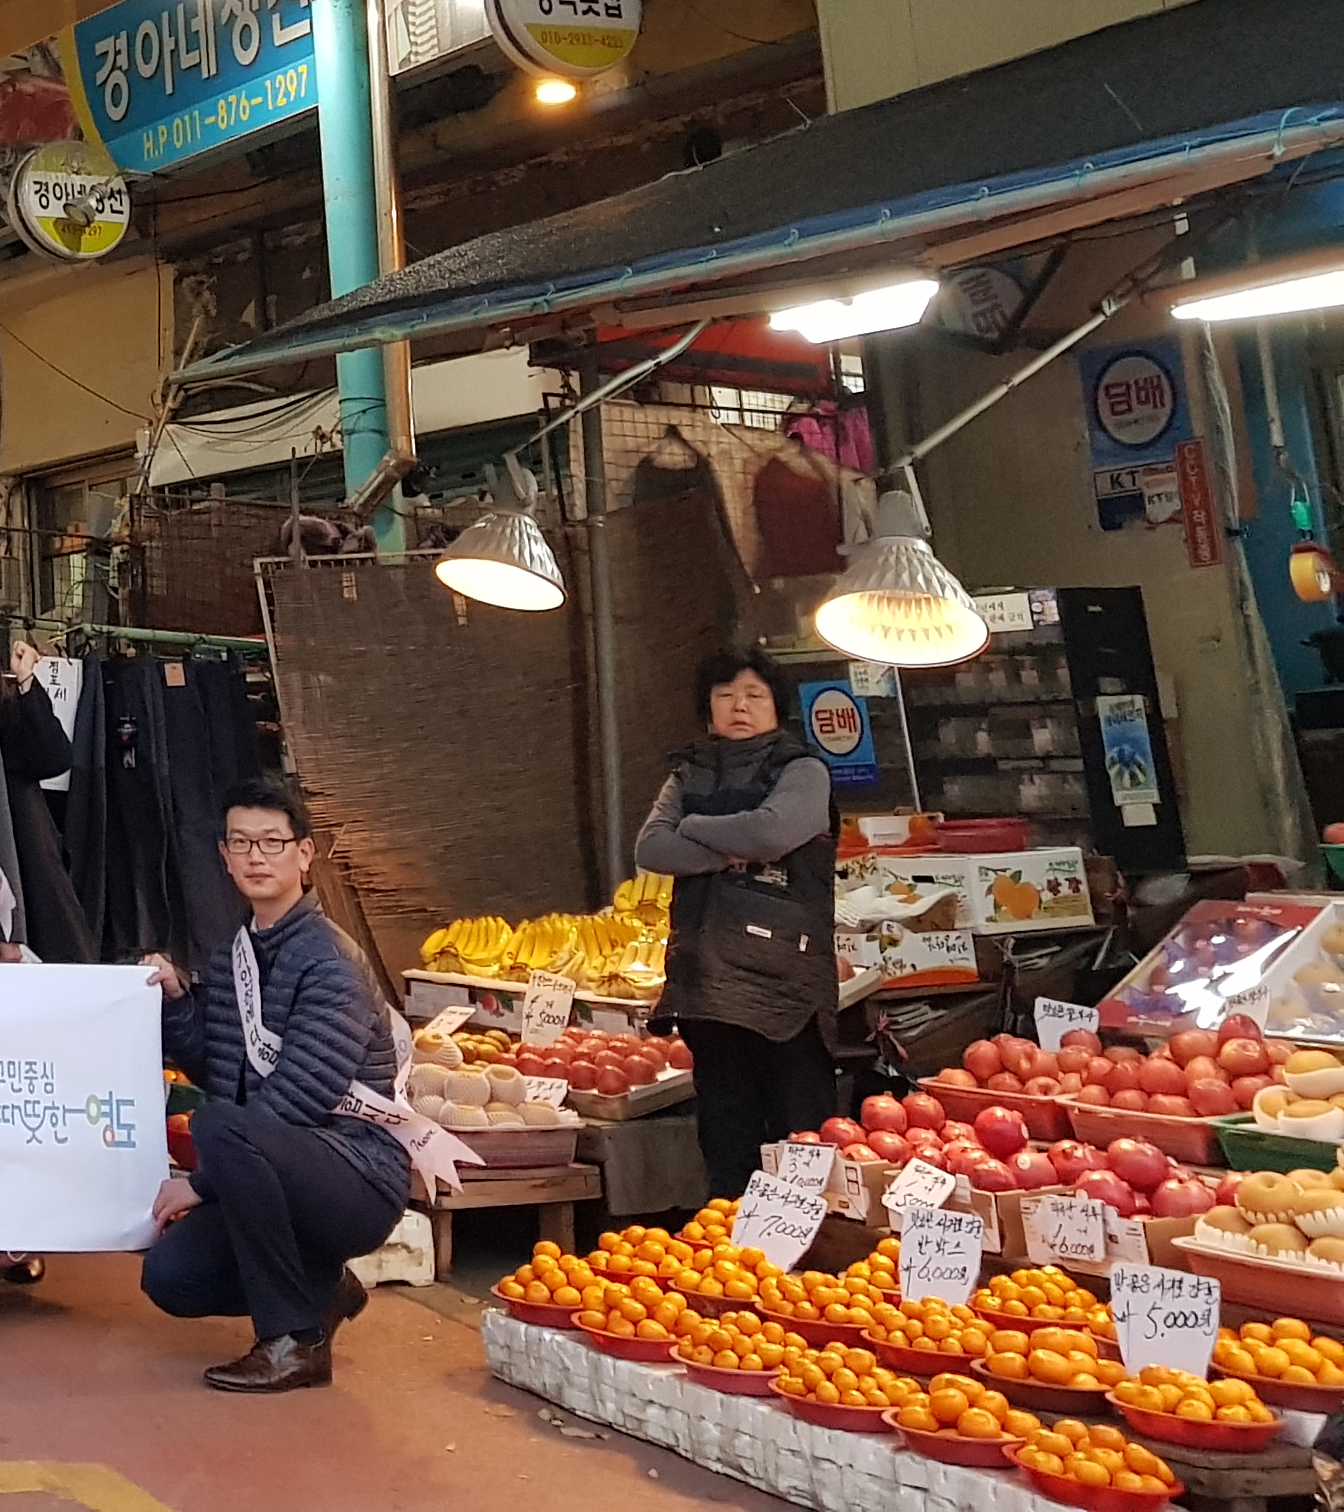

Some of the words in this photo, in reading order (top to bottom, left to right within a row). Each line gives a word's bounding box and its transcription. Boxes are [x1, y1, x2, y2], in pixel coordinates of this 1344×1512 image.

[171, 64, 309, 153] 011-876-1297
[1104, 373, 1167, 418] 담배
[1108, 468, 1140, 491] KT
[814, 706, 859, 736] 담배
